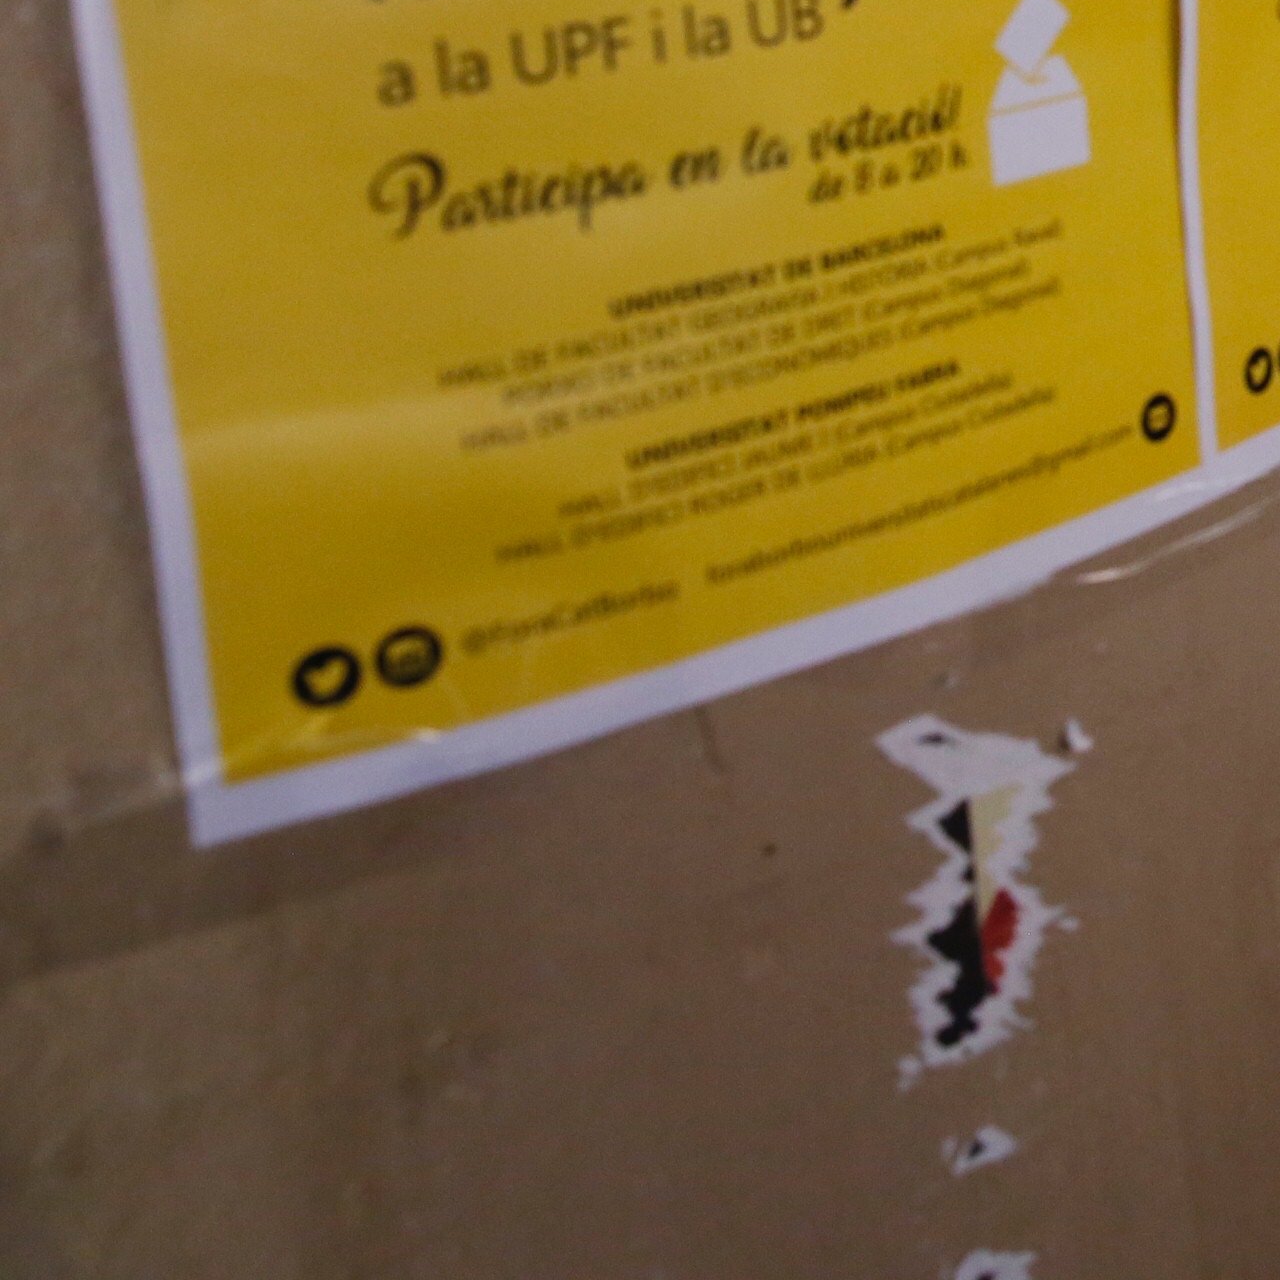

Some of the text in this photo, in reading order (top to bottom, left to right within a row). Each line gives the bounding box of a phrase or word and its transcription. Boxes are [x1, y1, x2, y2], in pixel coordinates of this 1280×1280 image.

[377, 56, 416, 109] a
[434, 37, 492, 97] la
[510, 14, 631, 87] UPF
[651, 6, 667, 65] i
[682, 0, 732, 58] la
[367, 150, 651, 242] Participa
[666, 145, 723, 186] en
[742, 127, 791, 178] la
